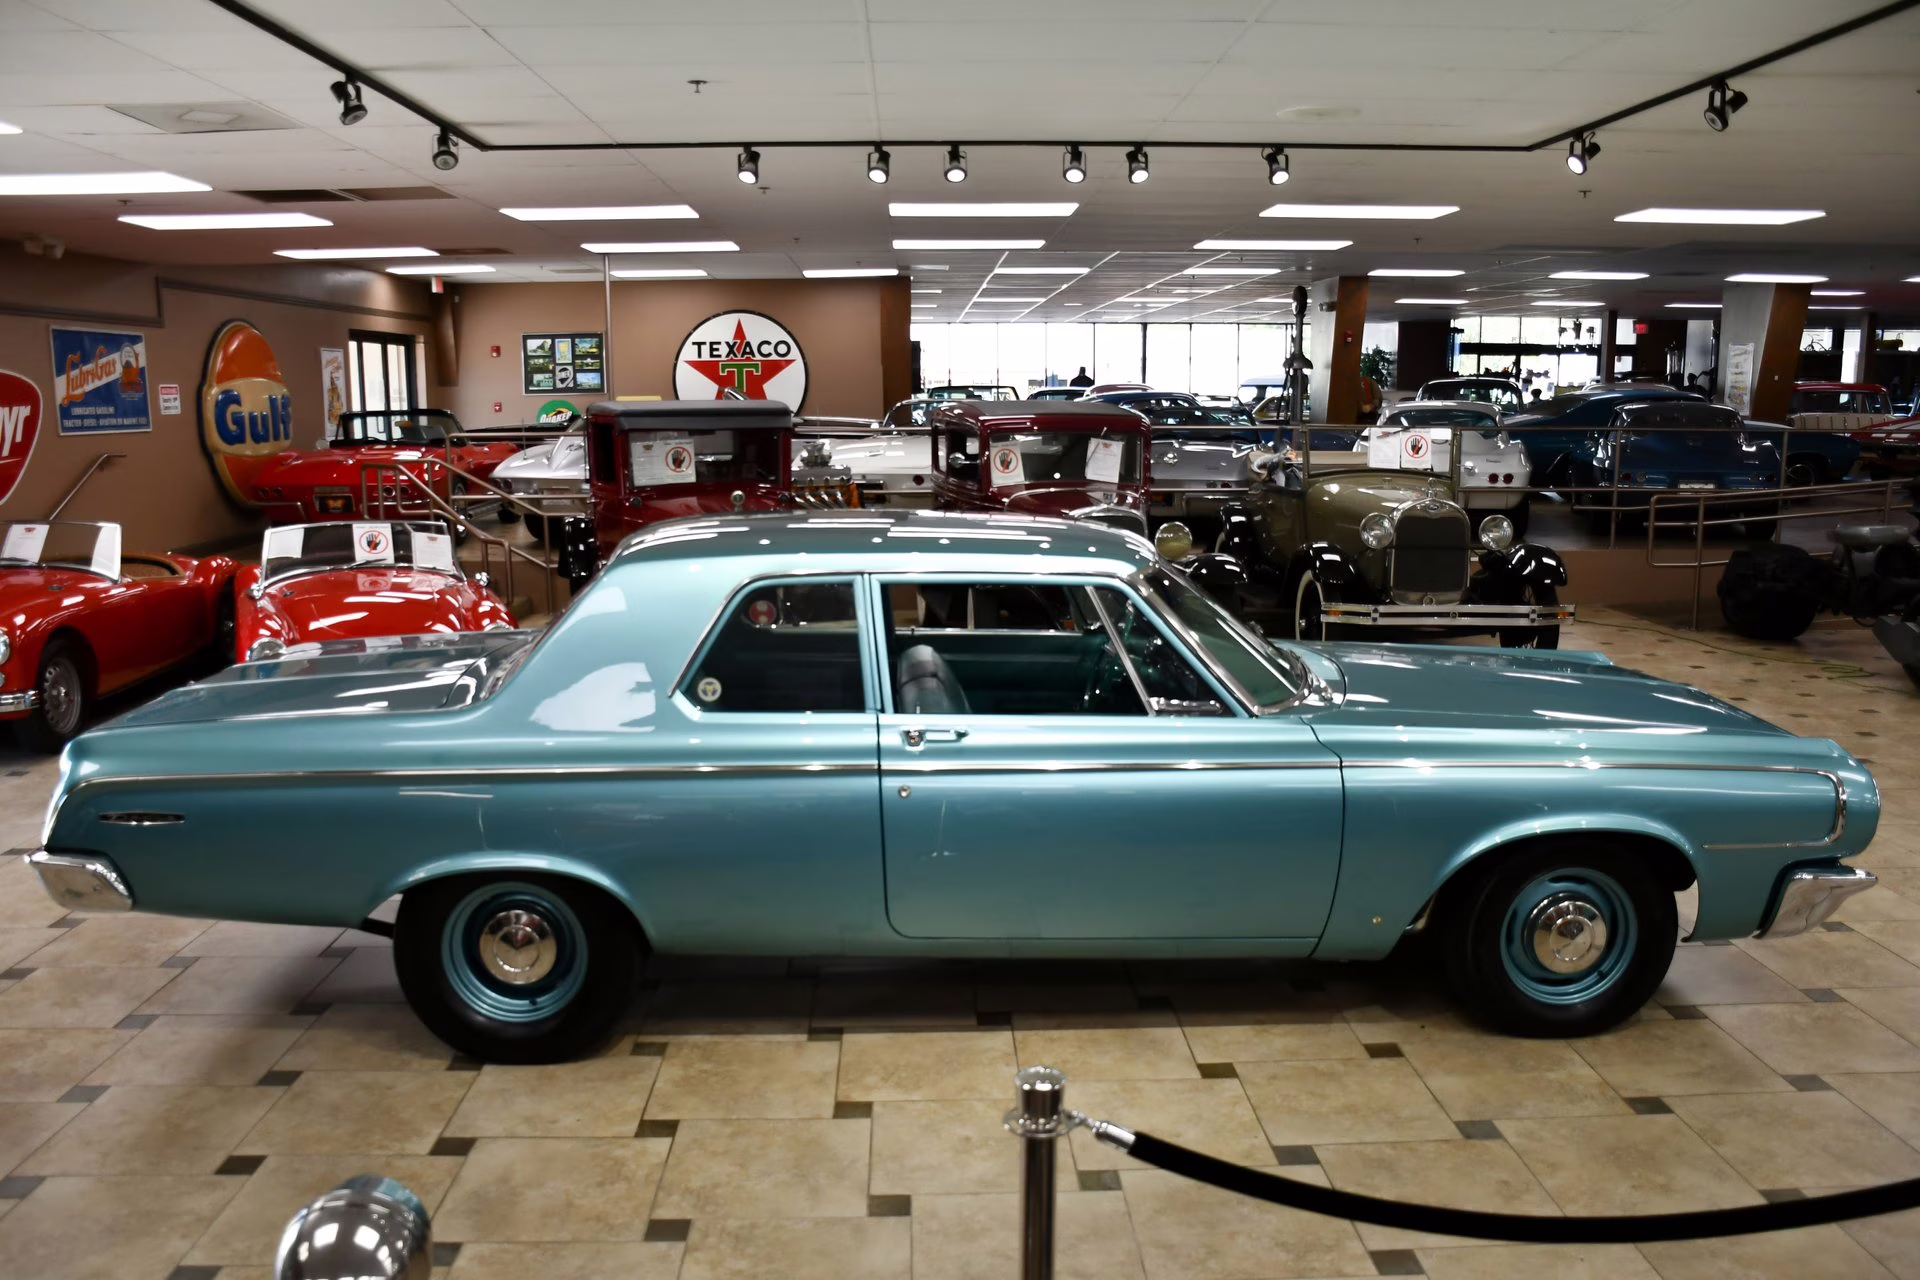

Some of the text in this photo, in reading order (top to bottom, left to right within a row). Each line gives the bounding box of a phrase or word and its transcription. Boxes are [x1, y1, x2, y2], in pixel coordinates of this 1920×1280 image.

[692, 340, 791, 358] TEXACO
[720, 362, 760, 393] T
[215, 389, 291, 446] Gulf
